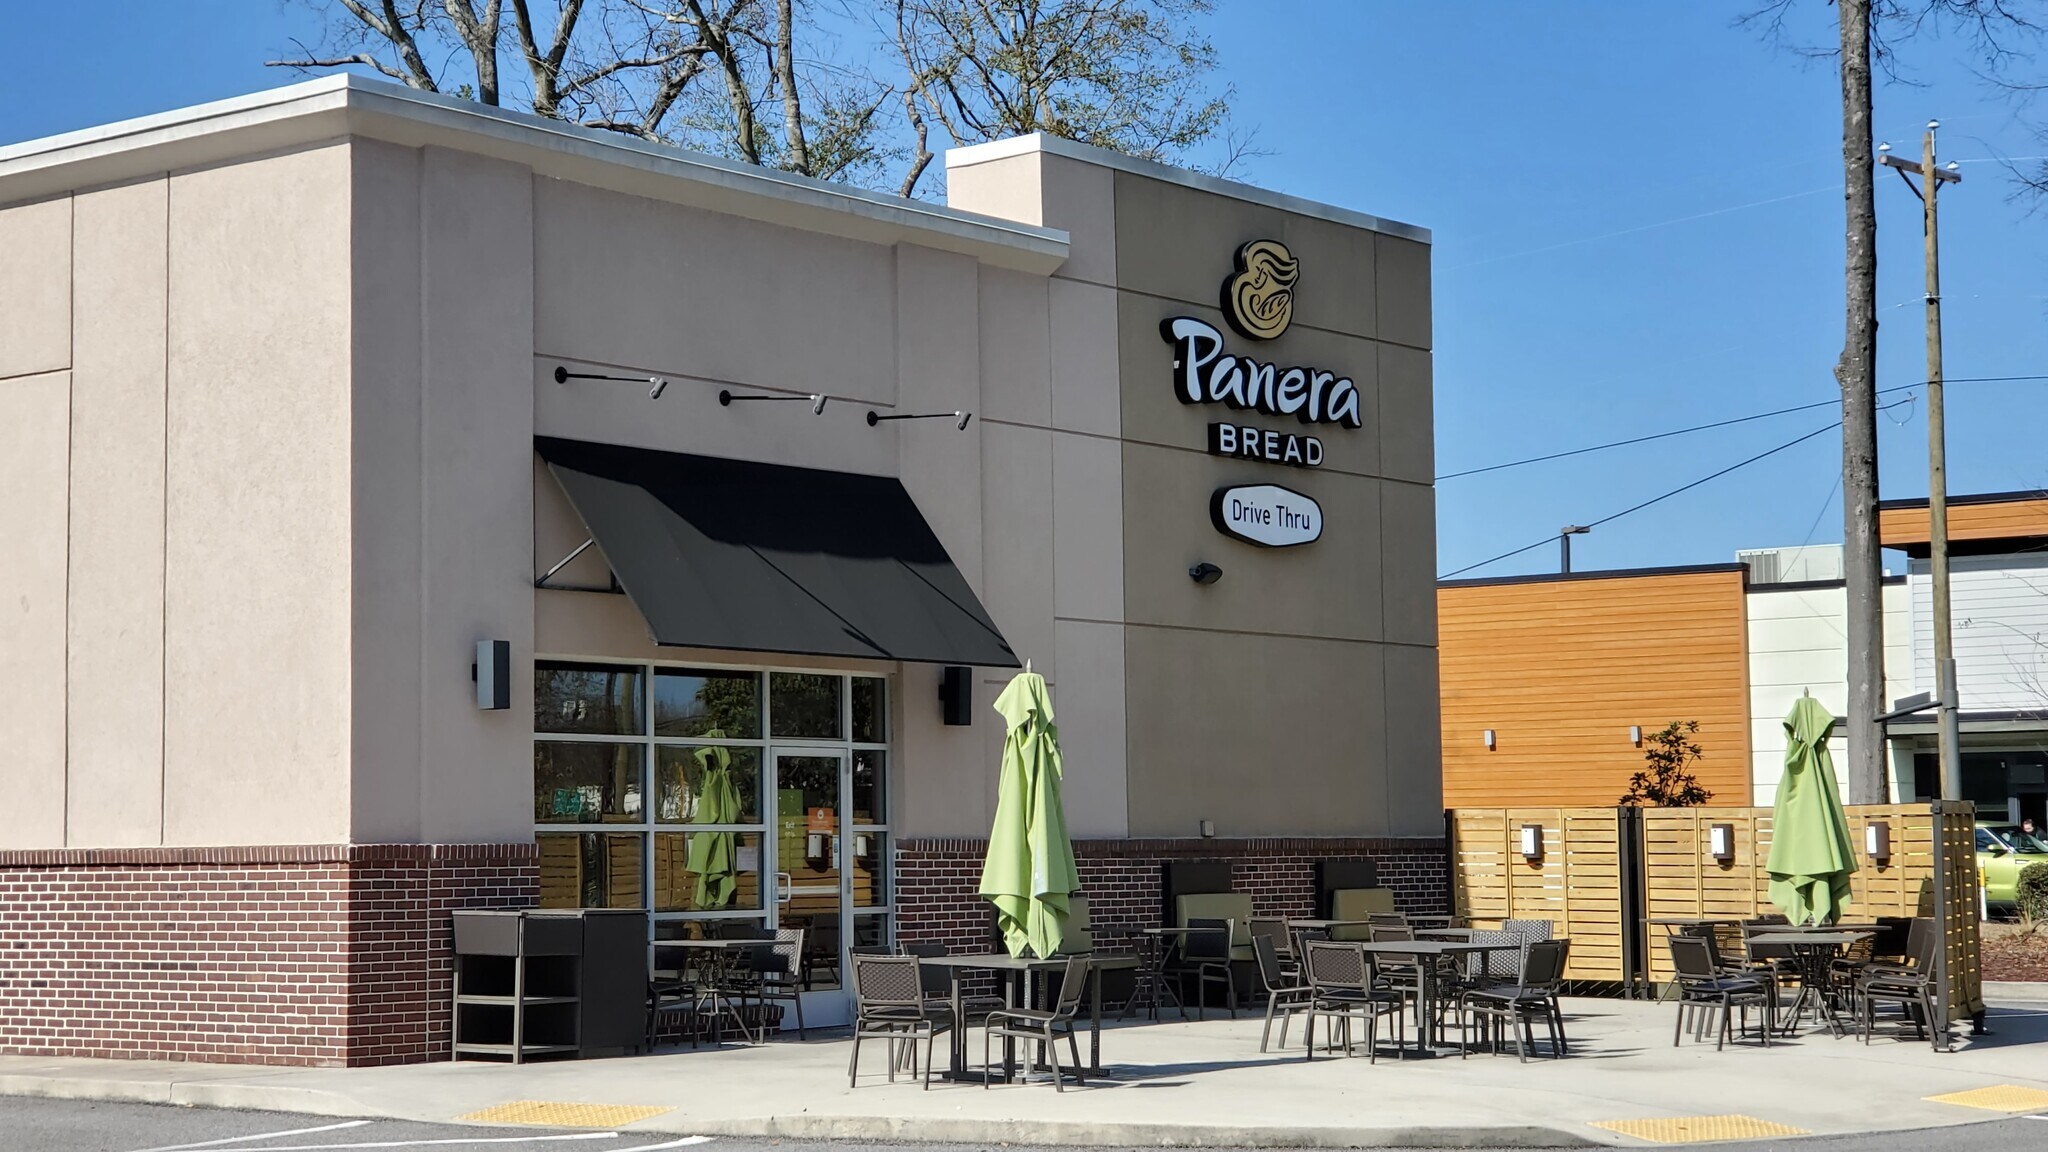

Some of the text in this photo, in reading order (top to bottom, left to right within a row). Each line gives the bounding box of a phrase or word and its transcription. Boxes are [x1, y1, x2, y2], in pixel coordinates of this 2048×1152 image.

[1171, 317, 1361, 427] Panera
[1218, 423, 1323, 466] BREAD
[1232, 498, 1311, 531] Drive Thru
